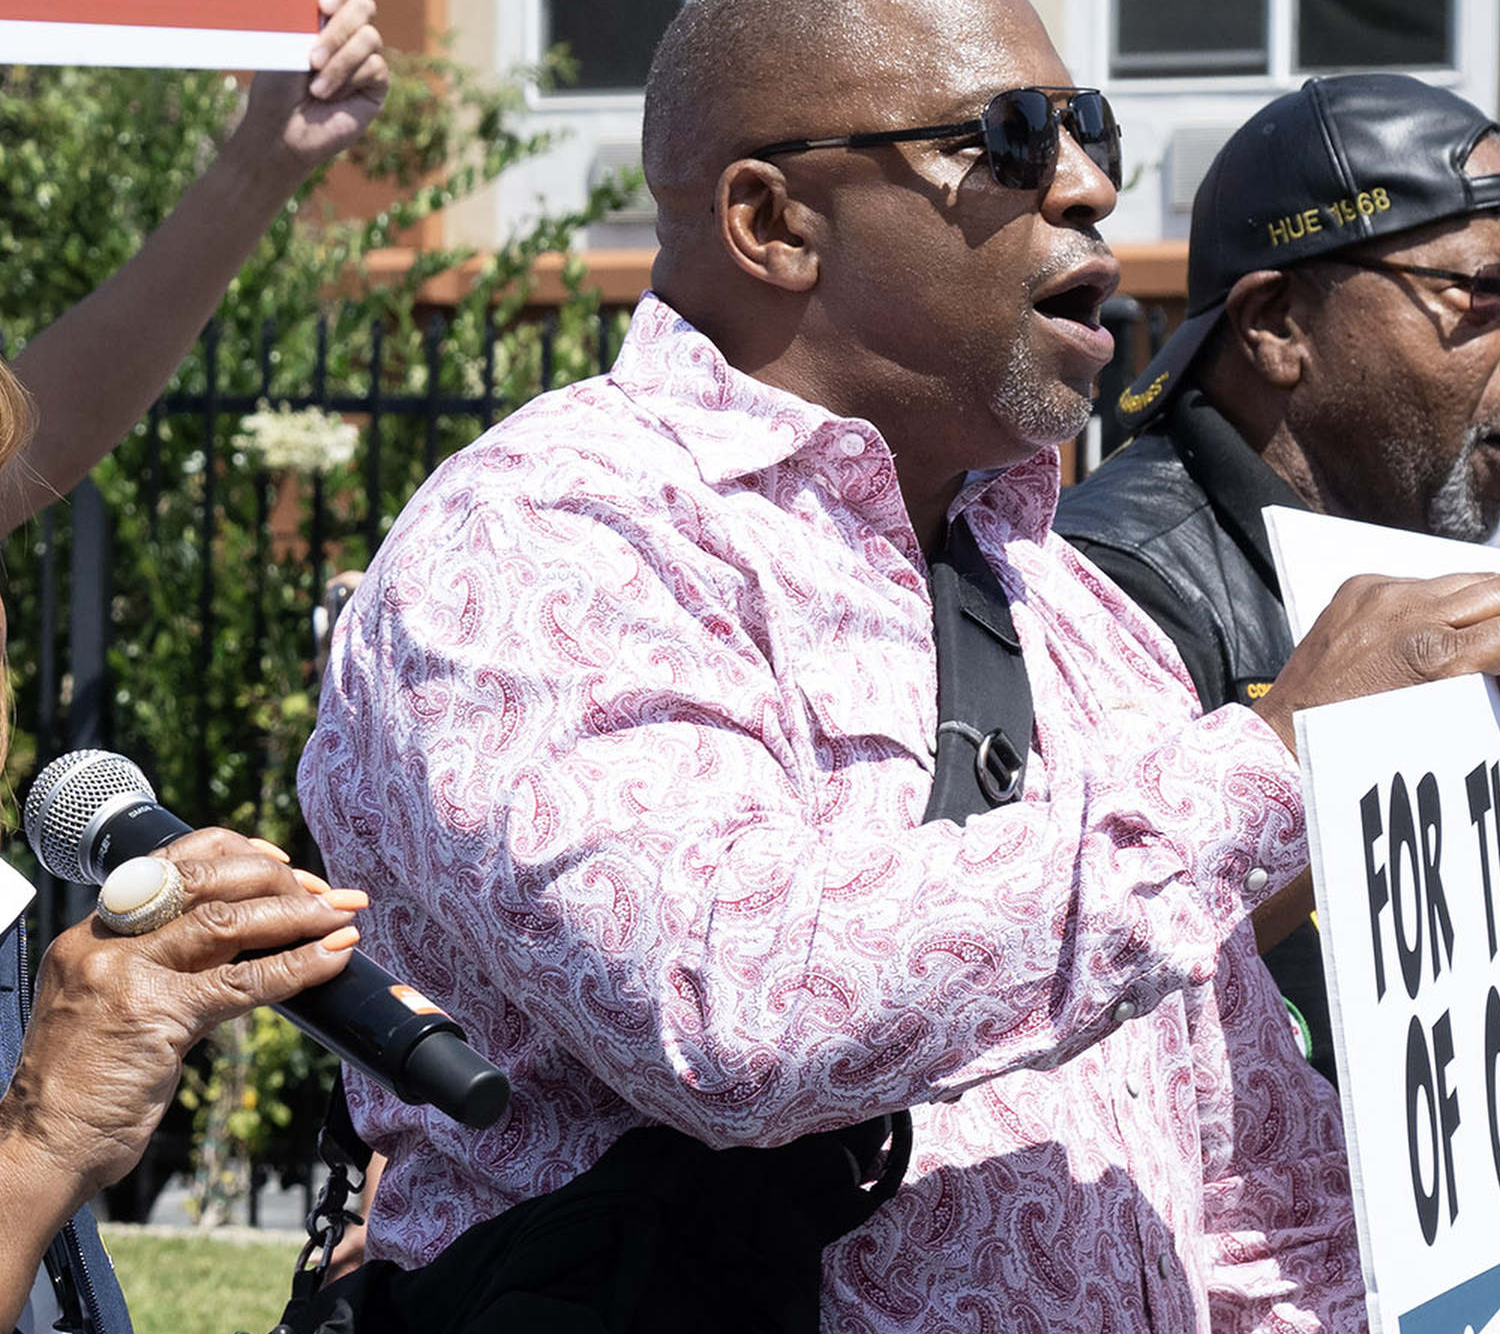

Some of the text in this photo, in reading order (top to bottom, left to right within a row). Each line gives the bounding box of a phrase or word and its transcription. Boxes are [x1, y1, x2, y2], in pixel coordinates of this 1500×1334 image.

[1267, 187, 1391, 247] HUE 1968
[1360, 772, 1455, 1003] FOR
[1406, 1010, 1460, 1247] OF
